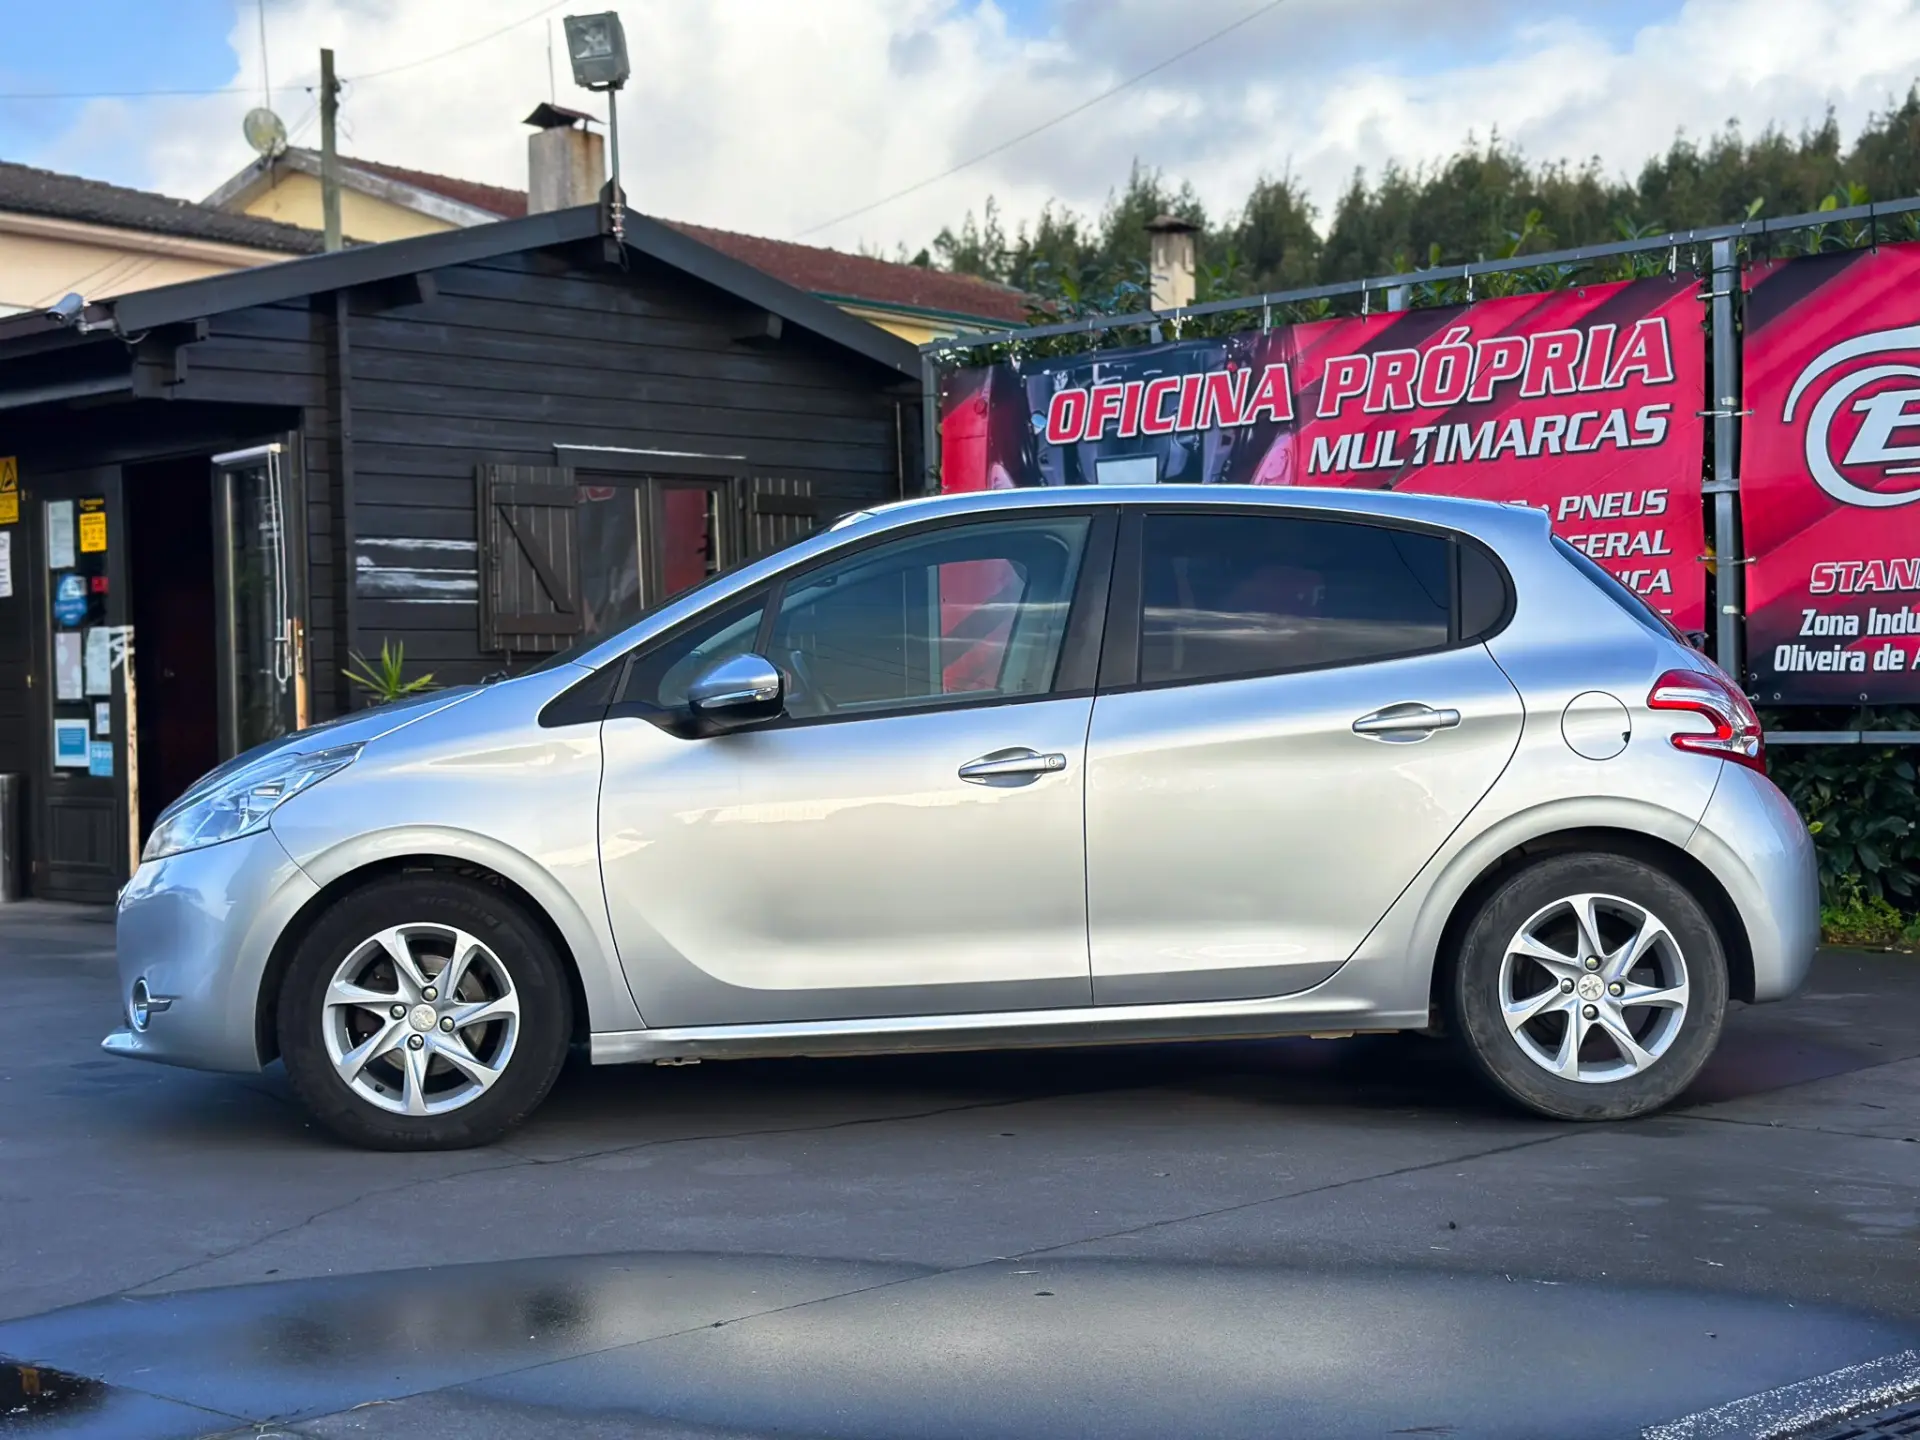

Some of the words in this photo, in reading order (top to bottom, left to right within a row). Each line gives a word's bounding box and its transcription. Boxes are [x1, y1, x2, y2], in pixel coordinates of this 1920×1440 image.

[1046, 362, 1294, 445] OFICINA
[1315, 316, 1676, 418] PRÓPRIA
[1307, 402, 1671, 474] MULTIMARCAS
[1556, 488, 1668, 521] PNEUS
[1809, 558, 1920, 594] STAN
[1799, 608, 1859, 637] Zona
[1773, 644, 1866, 672] Oliveira
[1872, 642, 1906, 671] de
